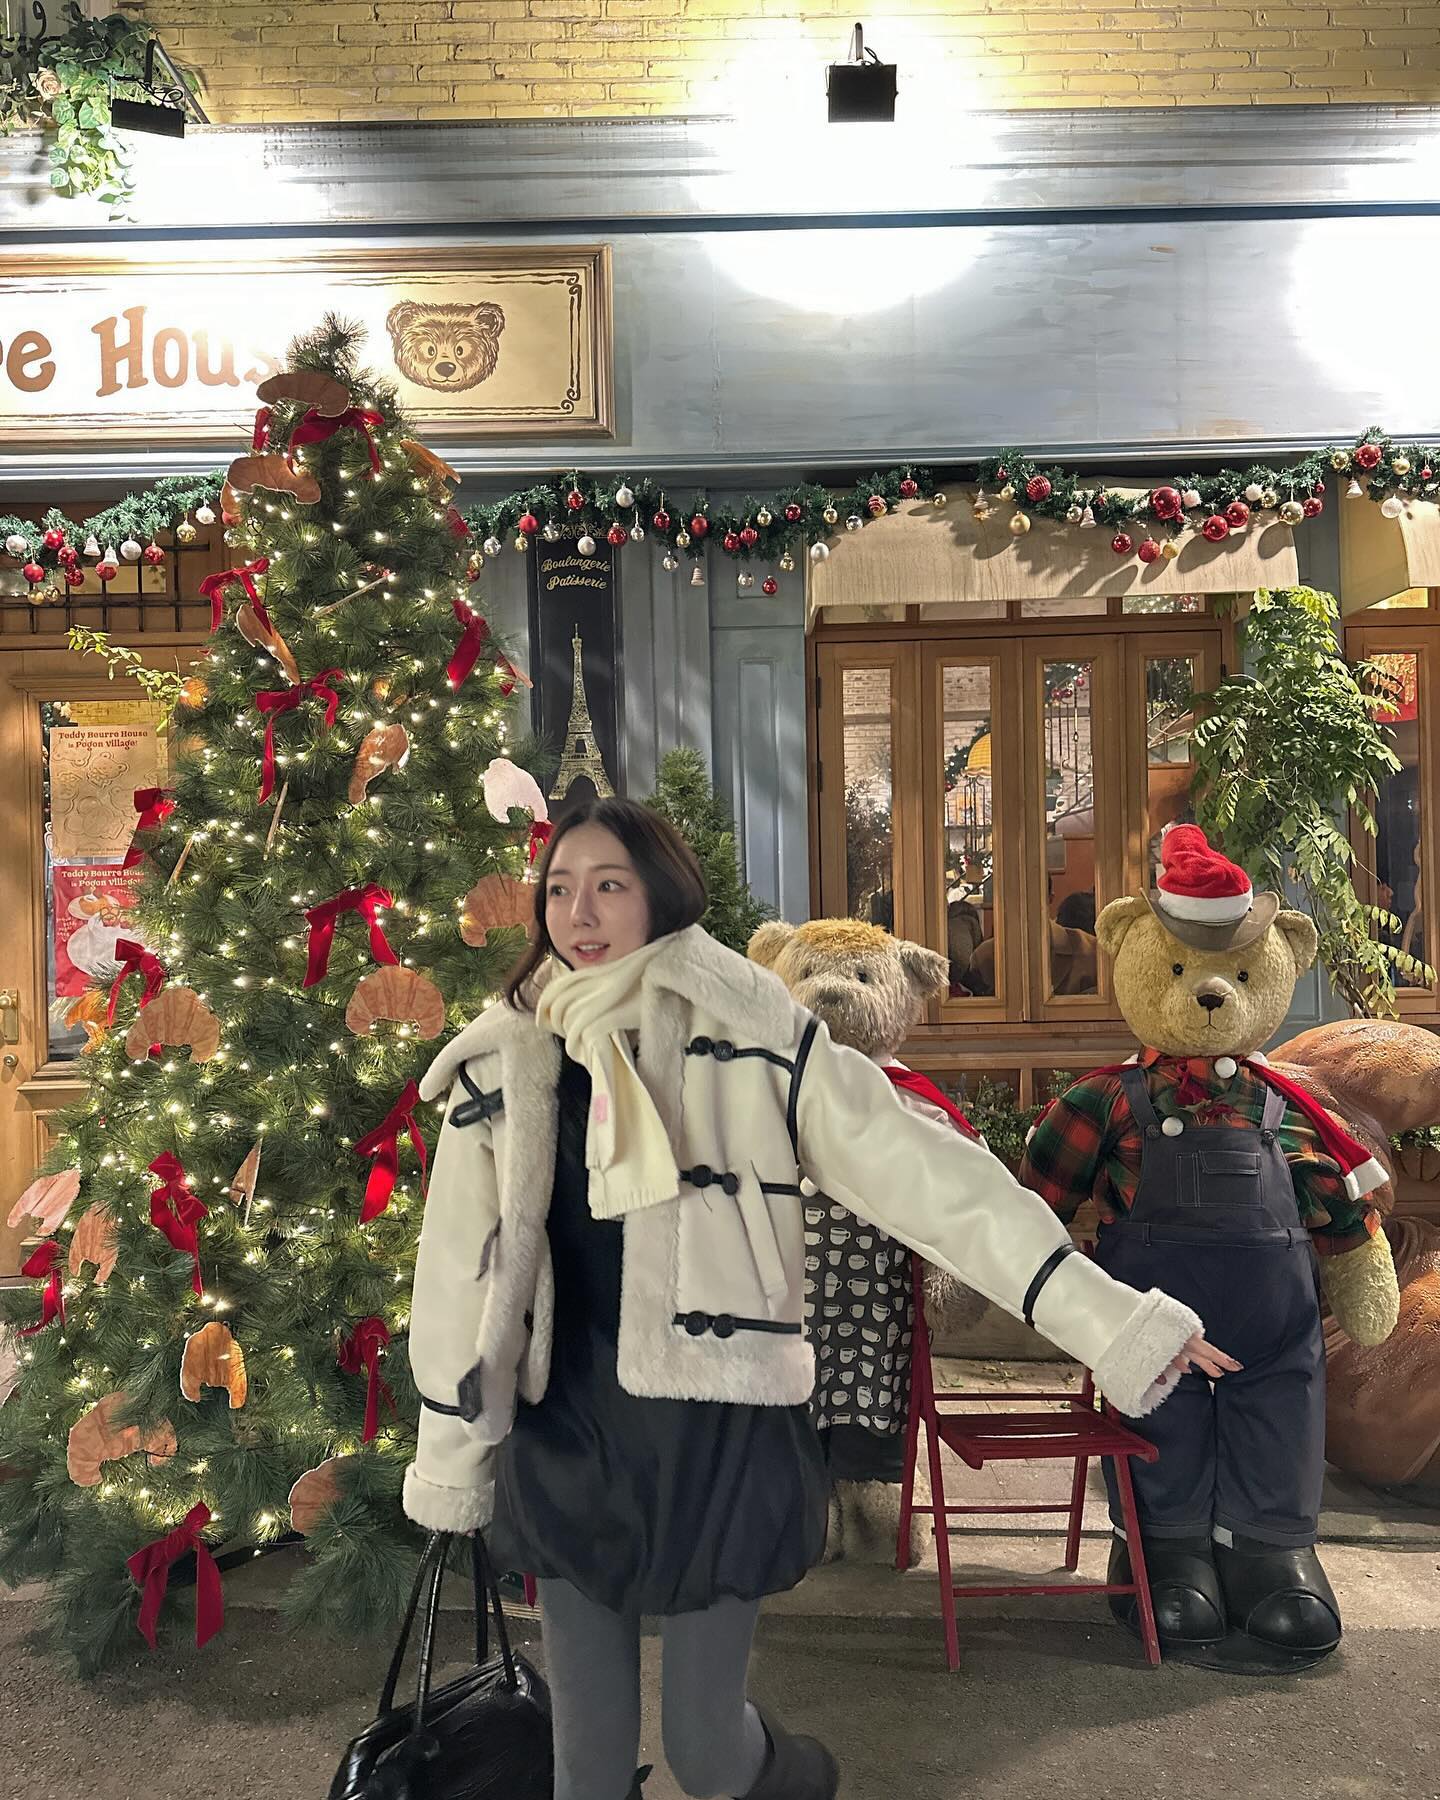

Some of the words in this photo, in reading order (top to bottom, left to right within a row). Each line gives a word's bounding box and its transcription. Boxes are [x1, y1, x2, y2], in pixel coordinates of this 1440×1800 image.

[0, 330, 56, 392] e
[91, 305, 283, 398] Hous
[541, 555, 611, 572] Boulangerie
[546, 574, 608, 591] Patisserie
[59, 731, 86, 741] Teddy
[121, 730, 148, 738] House
[61, 869, 89, 880] Teddy
